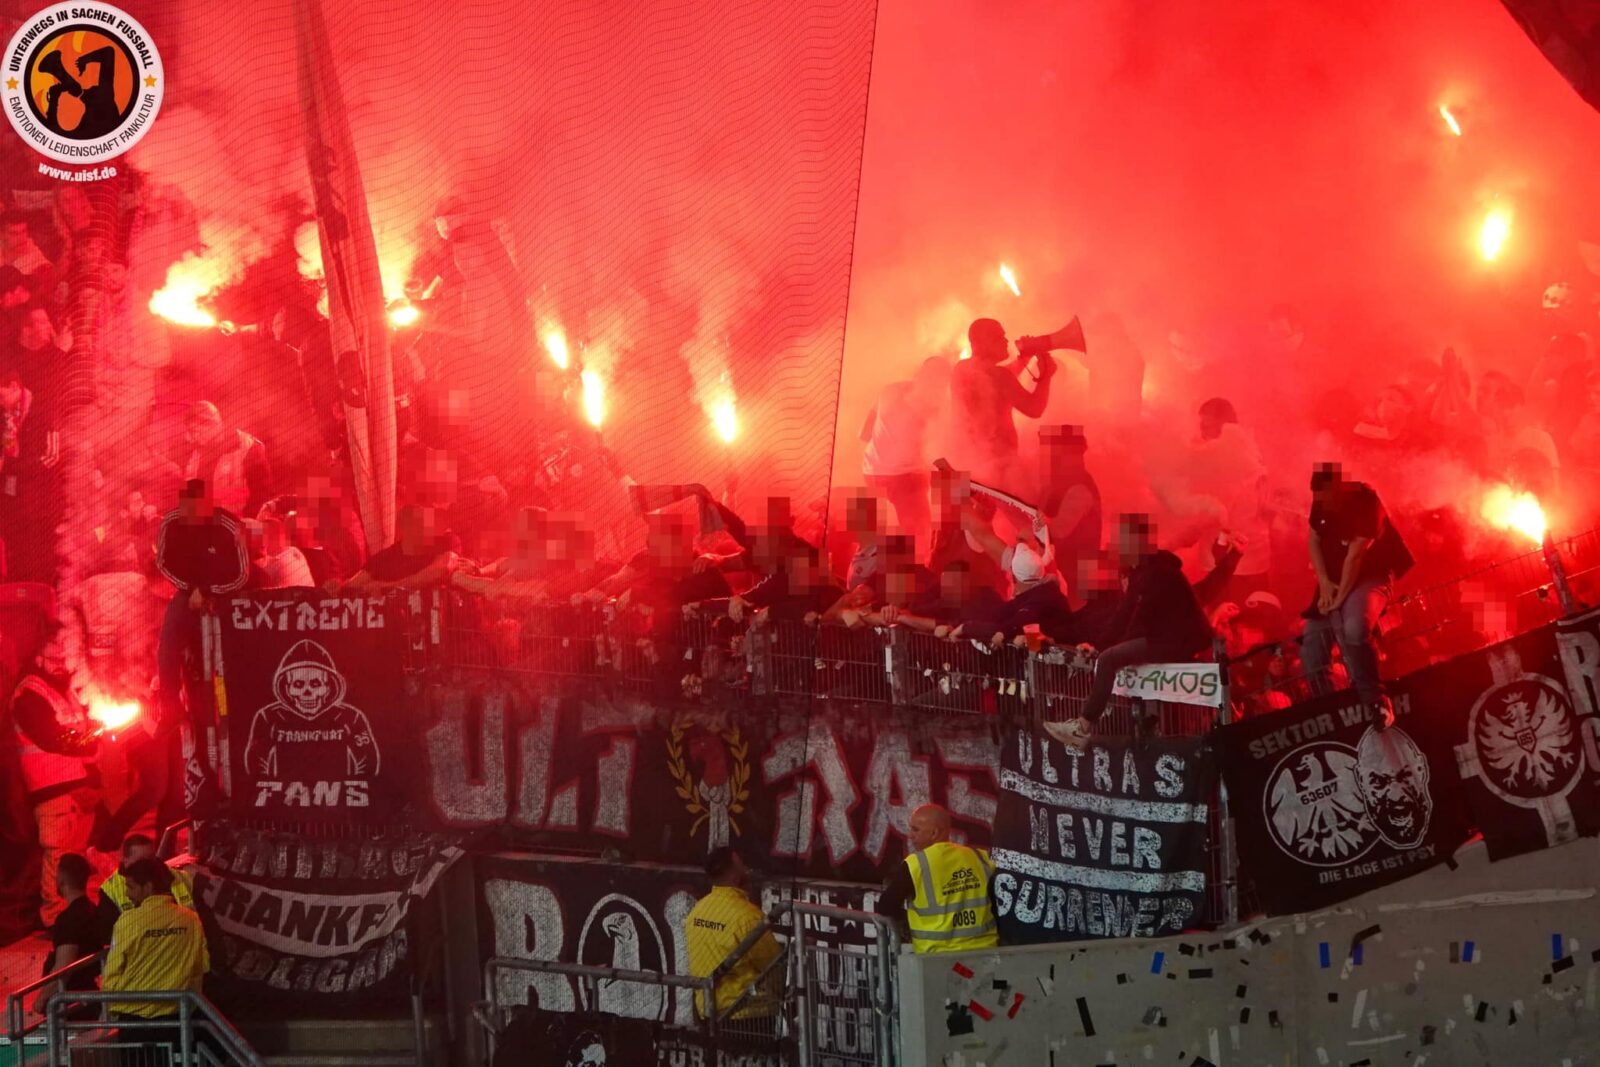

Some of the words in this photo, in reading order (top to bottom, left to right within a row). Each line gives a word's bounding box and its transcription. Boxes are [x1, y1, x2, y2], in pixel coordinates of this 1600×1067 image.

[231, 597, 385, 631] EXTREME
[277, 728, 345, 743] FRANKFURT
[1248, 713, 1335, 760] SEKTOR
[1017, 729, 1187, 799] ULTRAS
[254, 780, 370, 807] FANS
[1300, 782, 1339, 806] 63607
[1028, 804, 1163, 870] NEVER
[952, 868, 973, 881] SDS
[1318, 869, 1341, 884] DIE
[1344, 861, 1380, 879] LAGE
[693, 917, 727, 932] SECURITY
[952, 909, 977, 928] 0089
